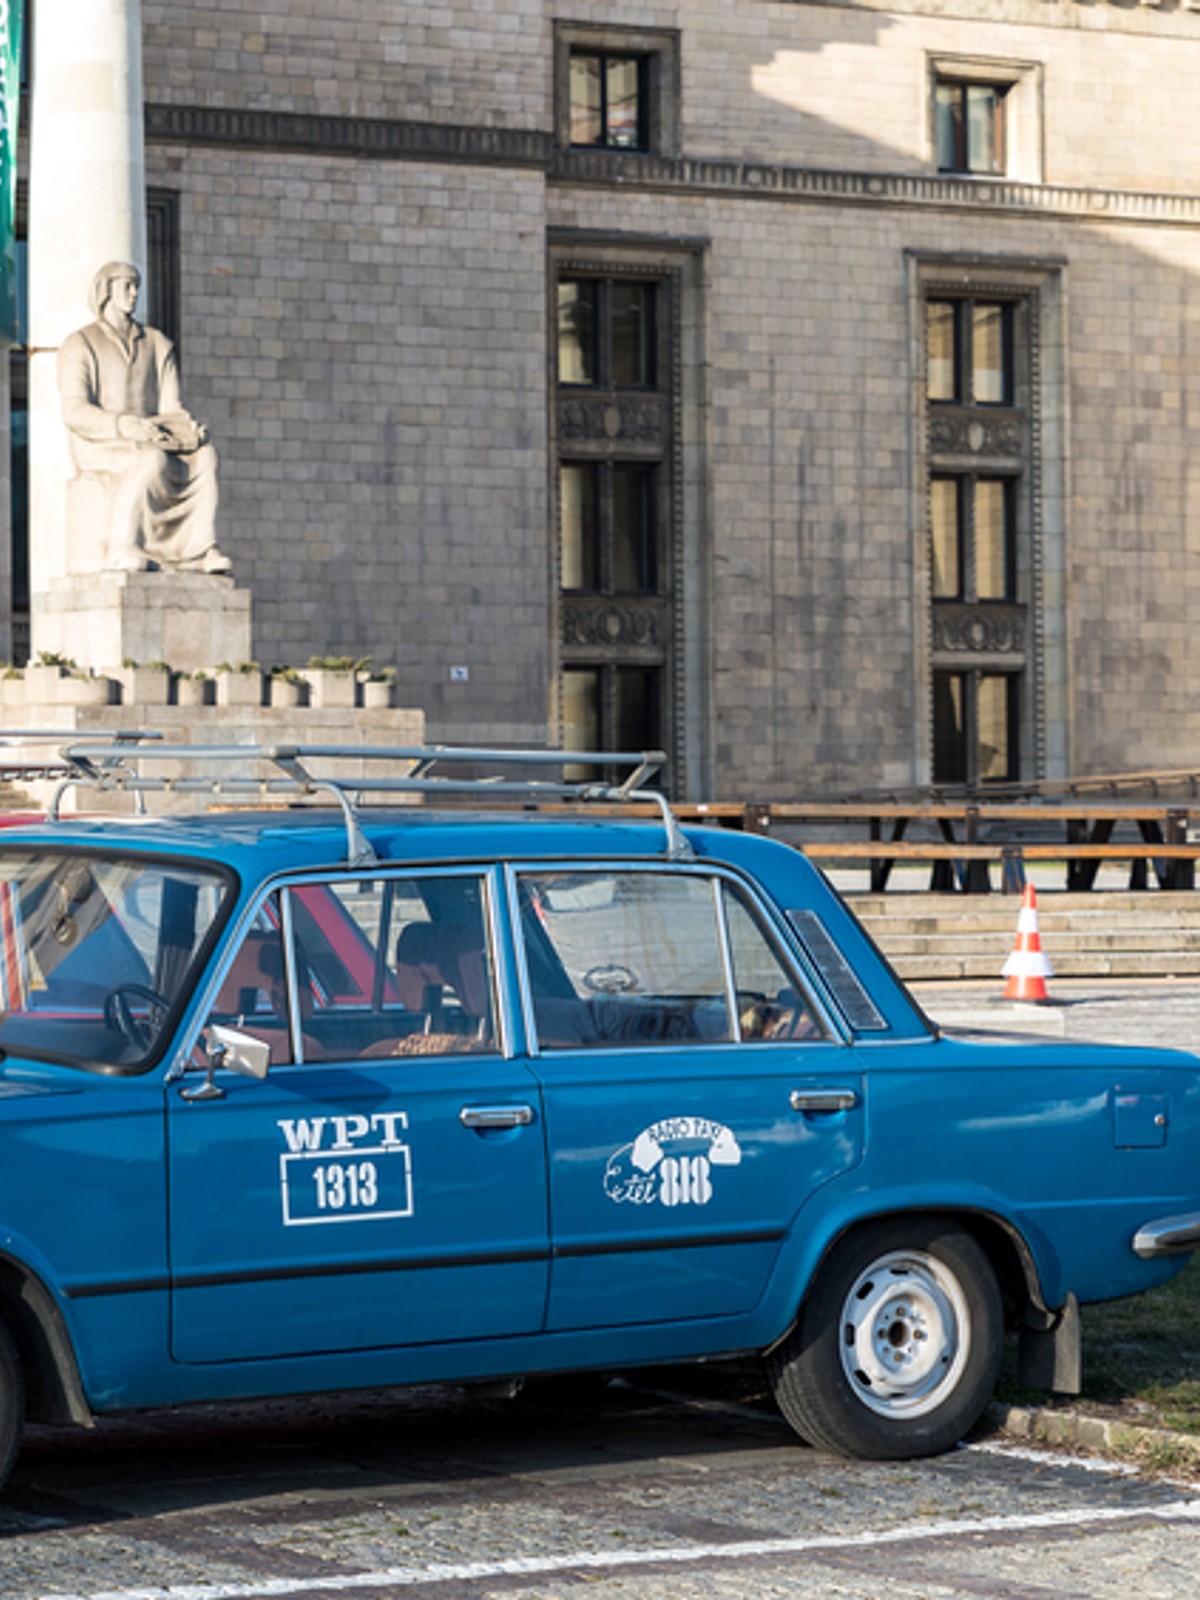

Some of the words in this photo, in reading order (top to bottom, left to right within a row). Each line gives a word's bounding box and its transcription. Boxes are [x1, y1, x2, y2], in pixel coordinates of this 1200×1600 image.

[277, 1111, 409, 1152] WPT
[648, 1118, 690, 1143] RADIO
[312, 1161, 379, 1209] 1313
[659, 1155, 713, 1206] 818
